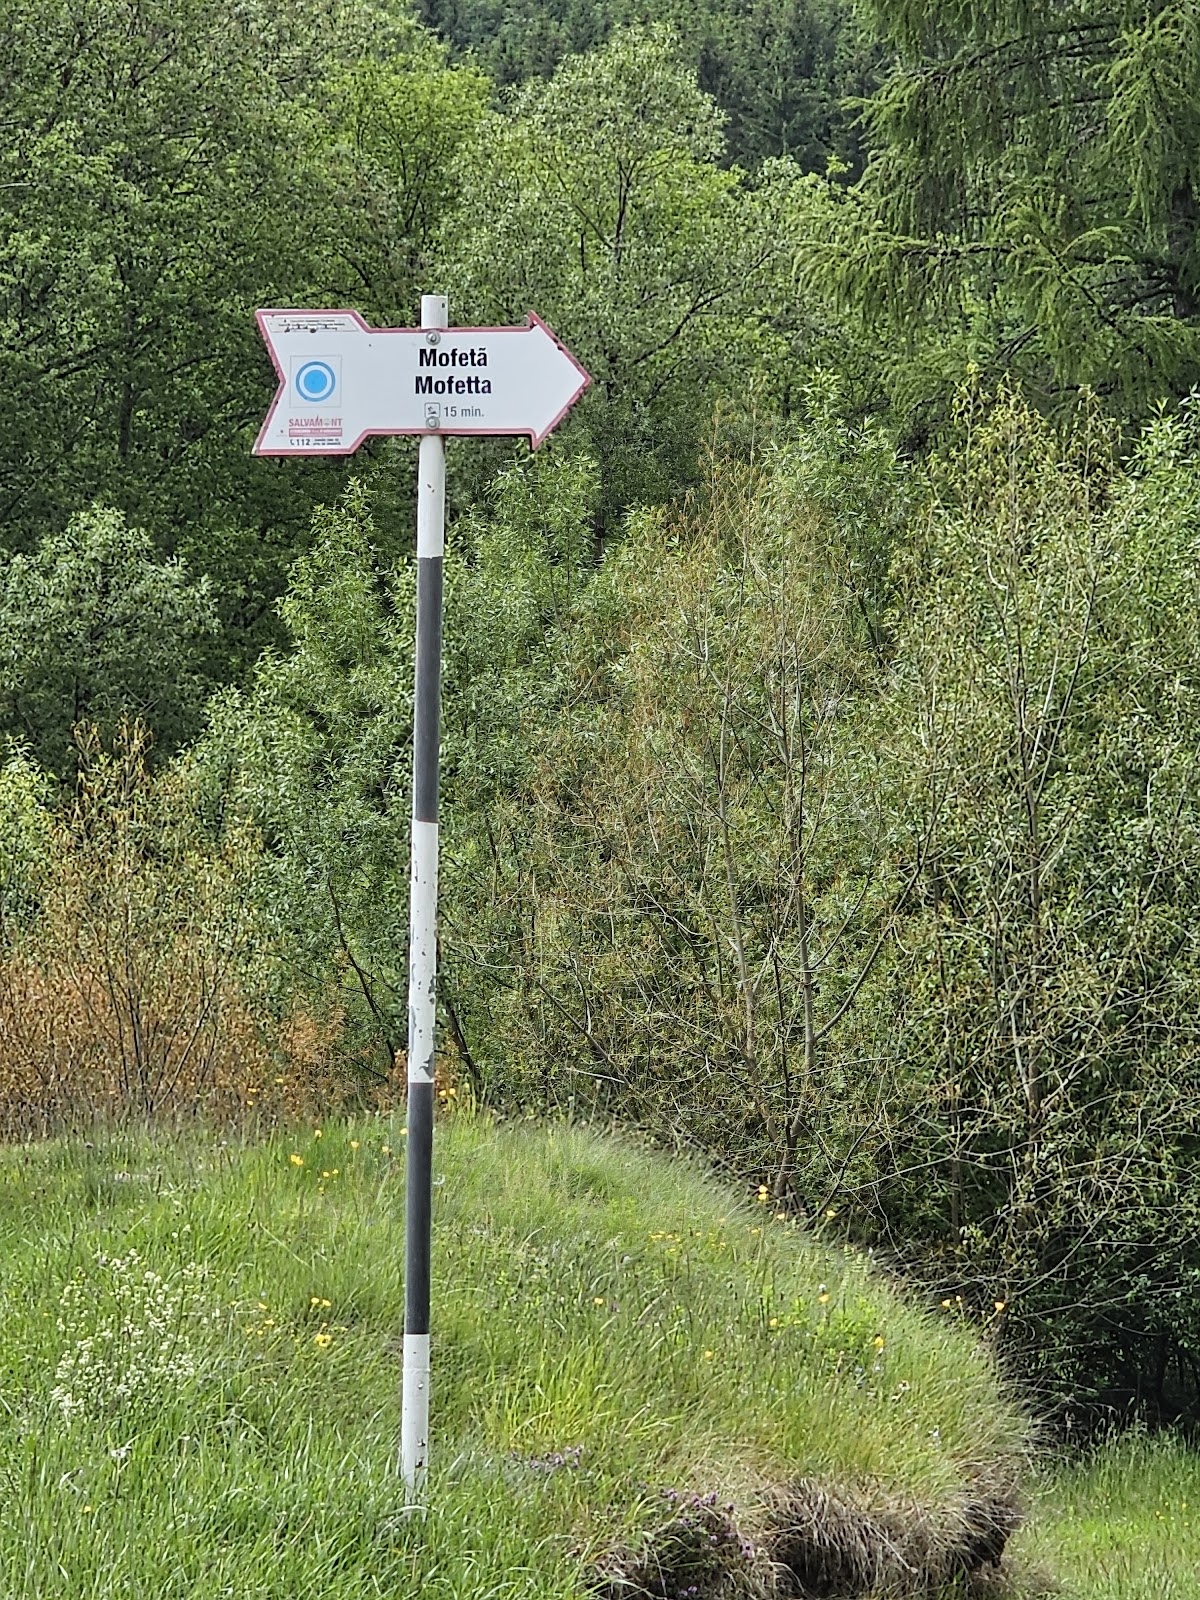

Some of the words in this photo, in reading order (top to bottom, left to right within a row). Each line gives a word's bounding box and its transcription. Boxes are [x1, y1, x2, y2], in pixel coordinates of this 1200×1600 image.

[415, 375, 492, 395] Mofetta
[443, 406, 457, 417] 15
[460, 406, 485, 417] min.
[296, 438, 311, 446] 112
